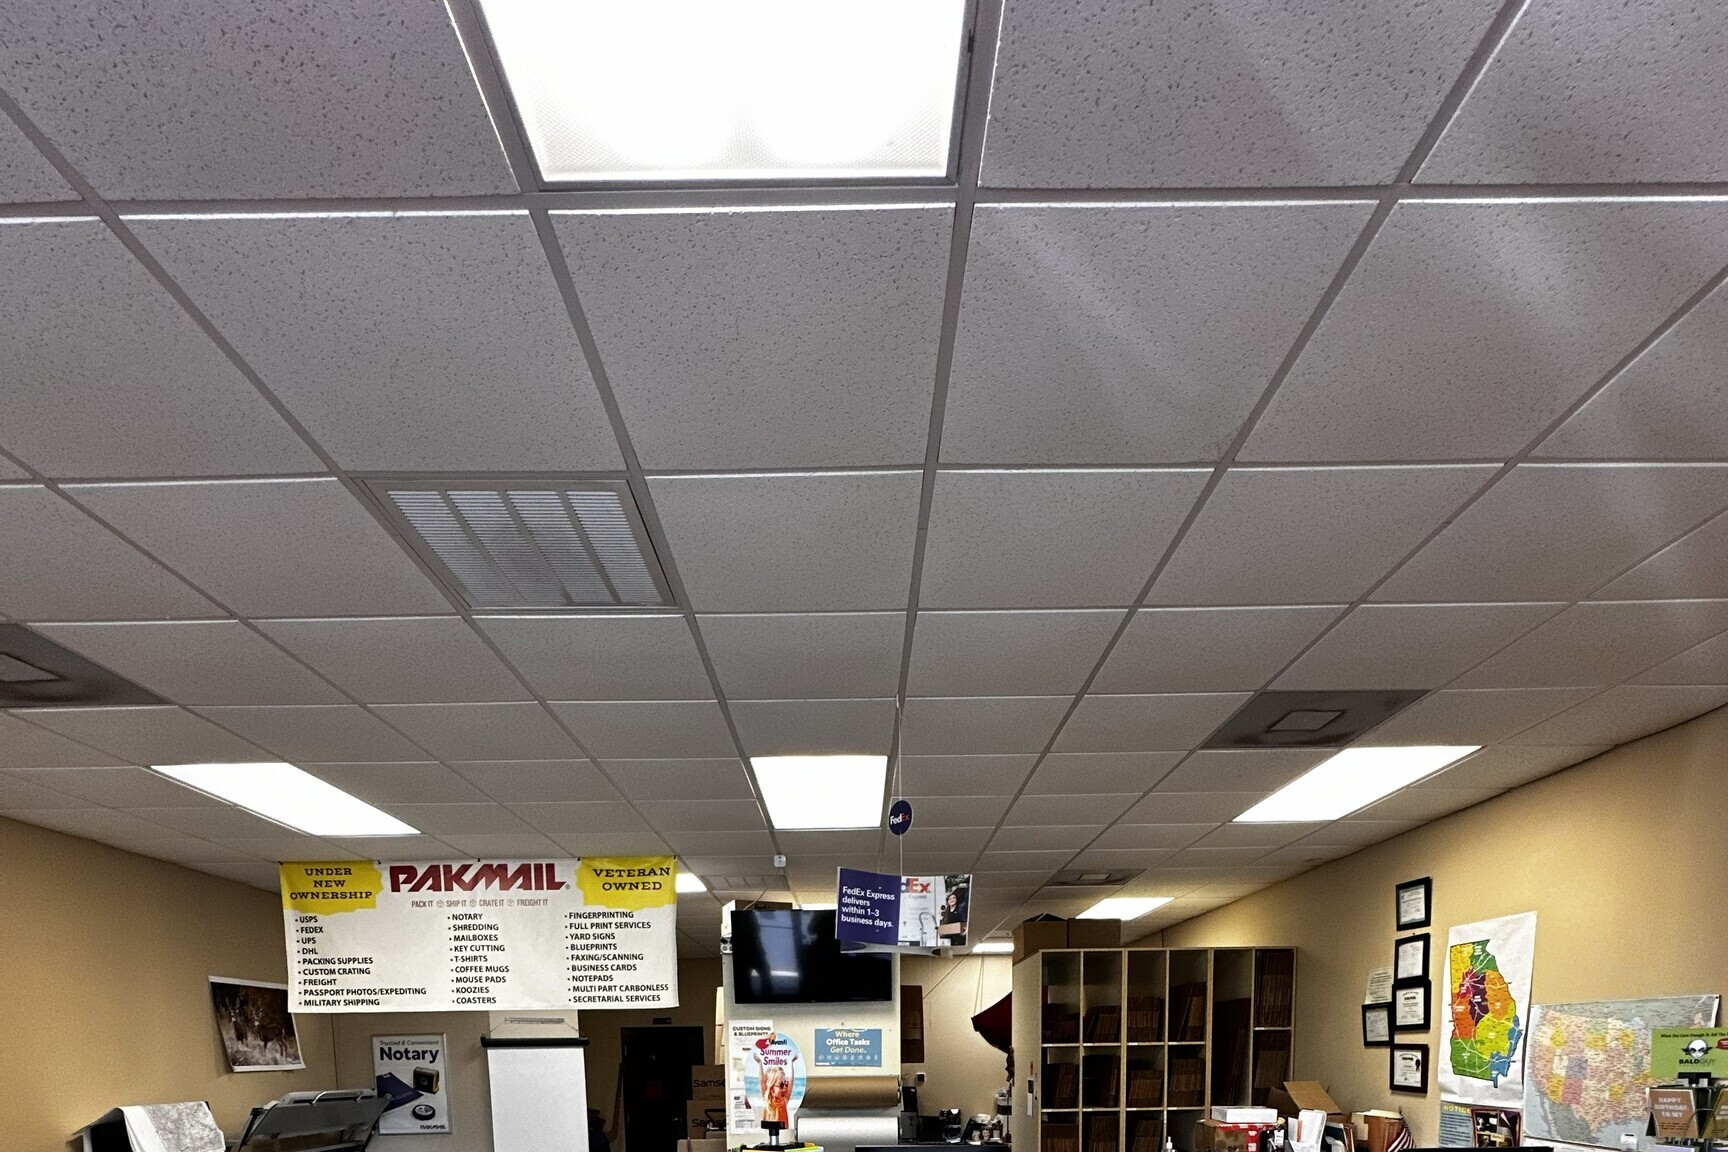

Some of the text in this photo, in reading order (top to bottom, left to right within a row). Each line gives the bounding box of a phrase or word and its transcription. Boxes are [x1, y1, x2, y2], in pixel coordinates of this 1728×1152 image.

[304, 868, 352, 876] UNDER
[592, 867, 670, 878] VETERAN
[389, 863, 566, 892] PAKMAIL
[313, 880, 346, 888] NEW
[602, 882, 662, 890] OWNED
[290, 891, 372, 900] OWNERSHIP
[842, 886, 895, 901] FedEx Express
[412, 900, 427, 908] PACK
[446, 900, 460, 908] SHIP
[842, 896, 870, 906] delivers
[842, 906, 865, 915] within
[300, 916, 318, 924] USPS
[841, 914, 894, 928] business days.
[300, 926, 324, 934] FEDEX
[454, 934, 498, 942] MAILBOXES
[302, 957, 373, 966] PACKING SUPPLIES
[346, 988, 427, 996] PHOTOS/EXPEDITING
[304, 999, 342, 1007] MILITARY
[826, 1038, 849, 1046] Office
[380, 1047, 439, 1064] Notary
[763, 1056, 788, 1066] Smiles
